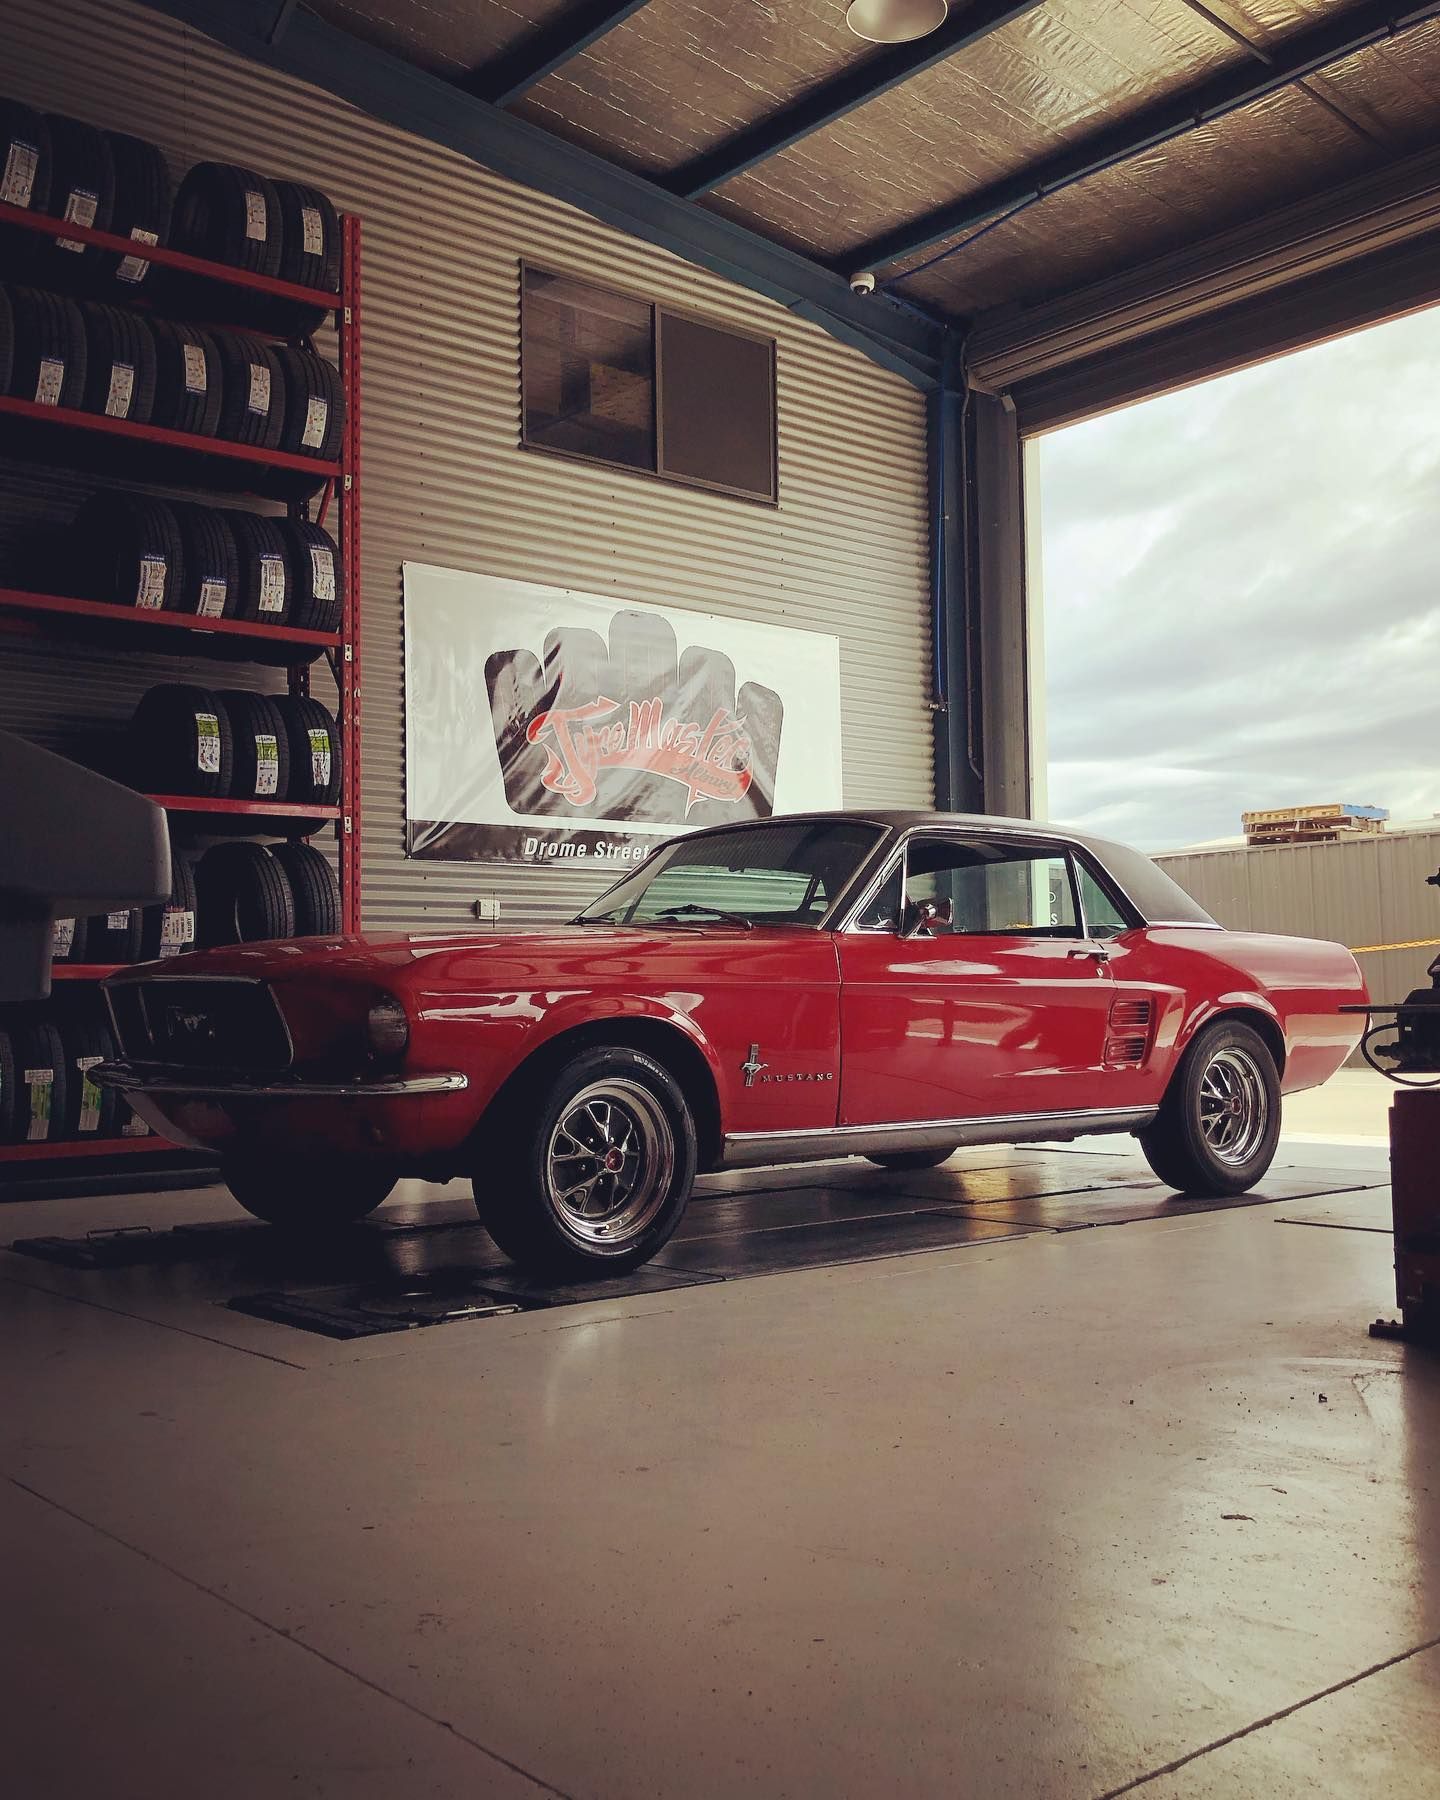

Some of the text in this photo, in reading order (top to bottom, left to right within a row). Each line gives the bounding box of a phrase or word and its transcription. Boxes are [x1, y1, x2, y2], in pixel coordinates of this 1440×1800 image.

[524, 837, 651, 861] Drome Street
[763, 1072, 833, 1083] MUSTANG
